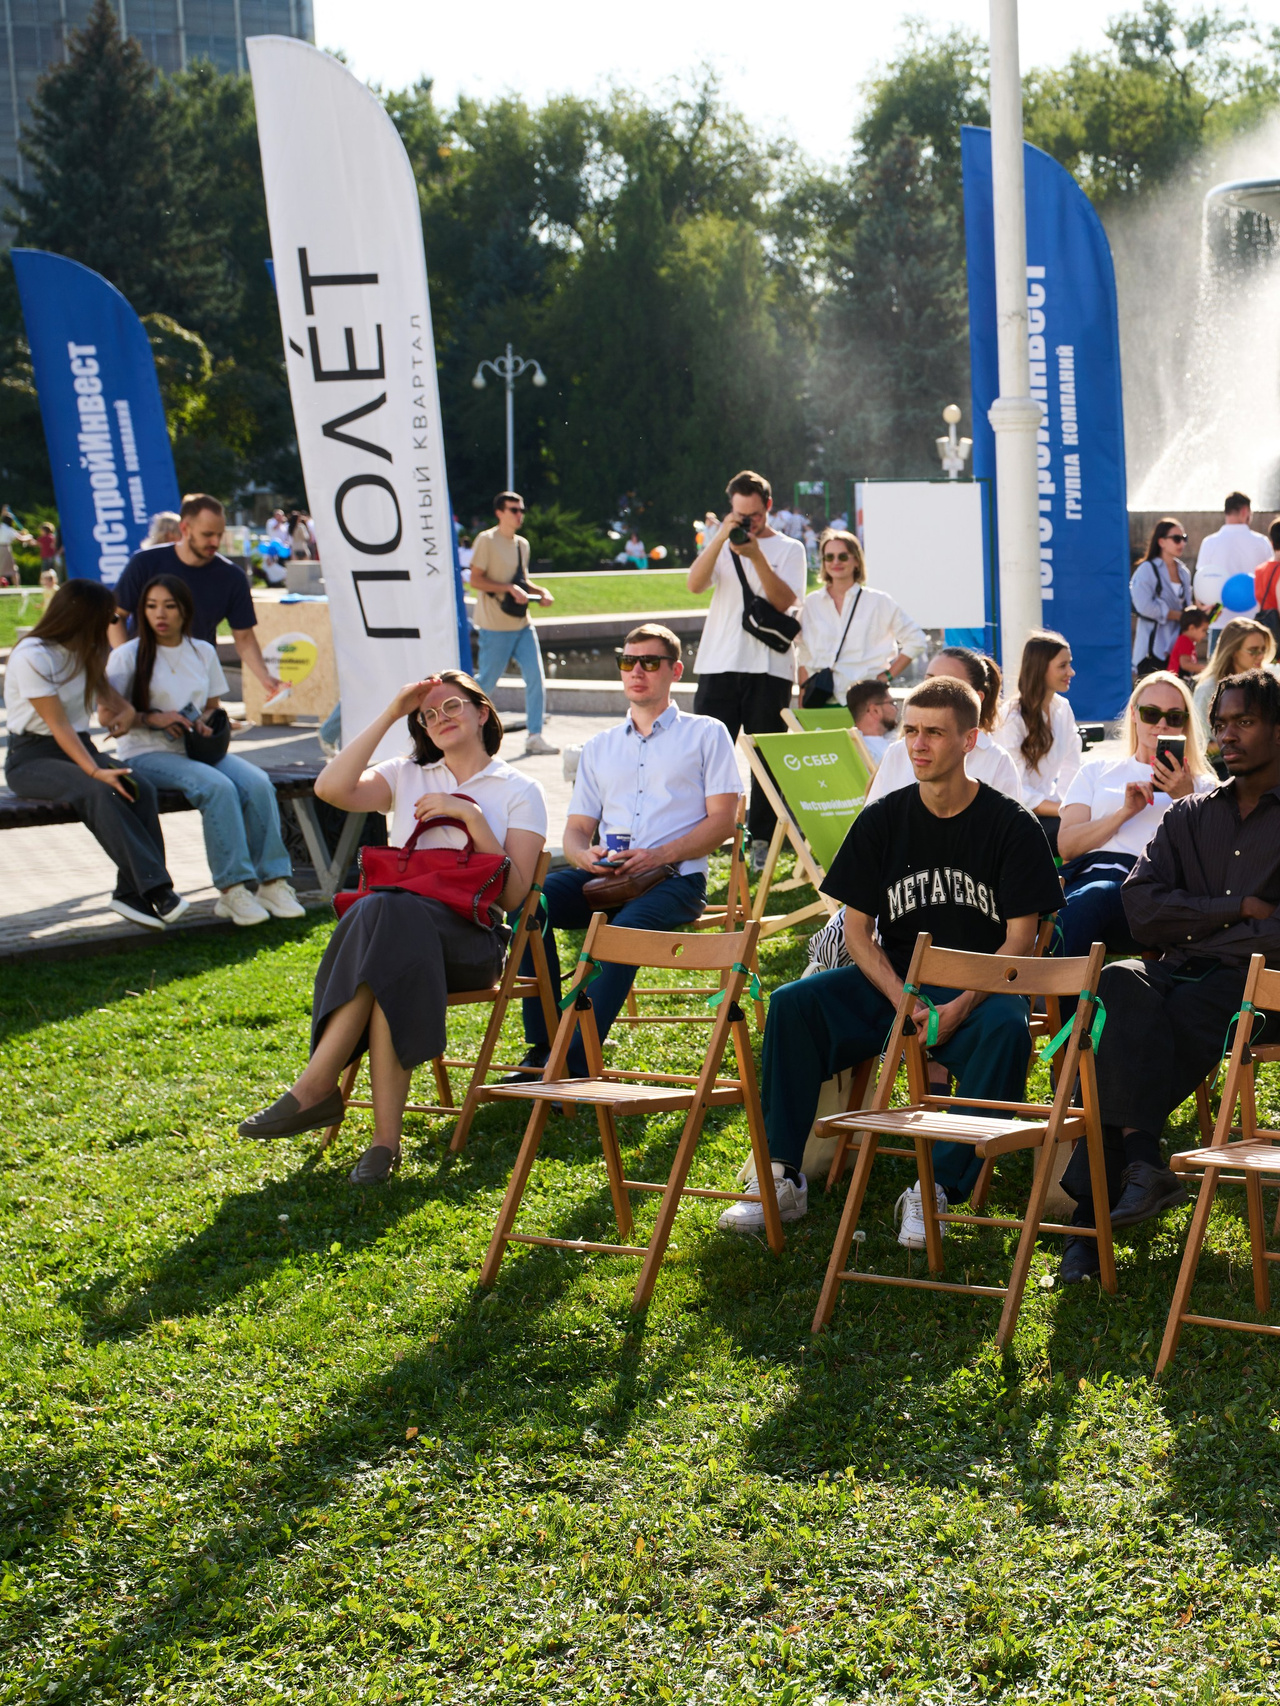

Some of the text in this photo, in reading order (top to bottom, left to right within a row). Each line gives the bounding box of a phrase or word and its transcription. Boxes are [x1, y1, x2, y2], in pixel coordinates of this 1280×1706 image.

[410, 314, 440, 577] УМНЫЙ КВАРТАЛ
[1055, 345, 1082, 520] ГРУППА КОМПАНИЙ
[802, 753, 839, 767] СБЕР
